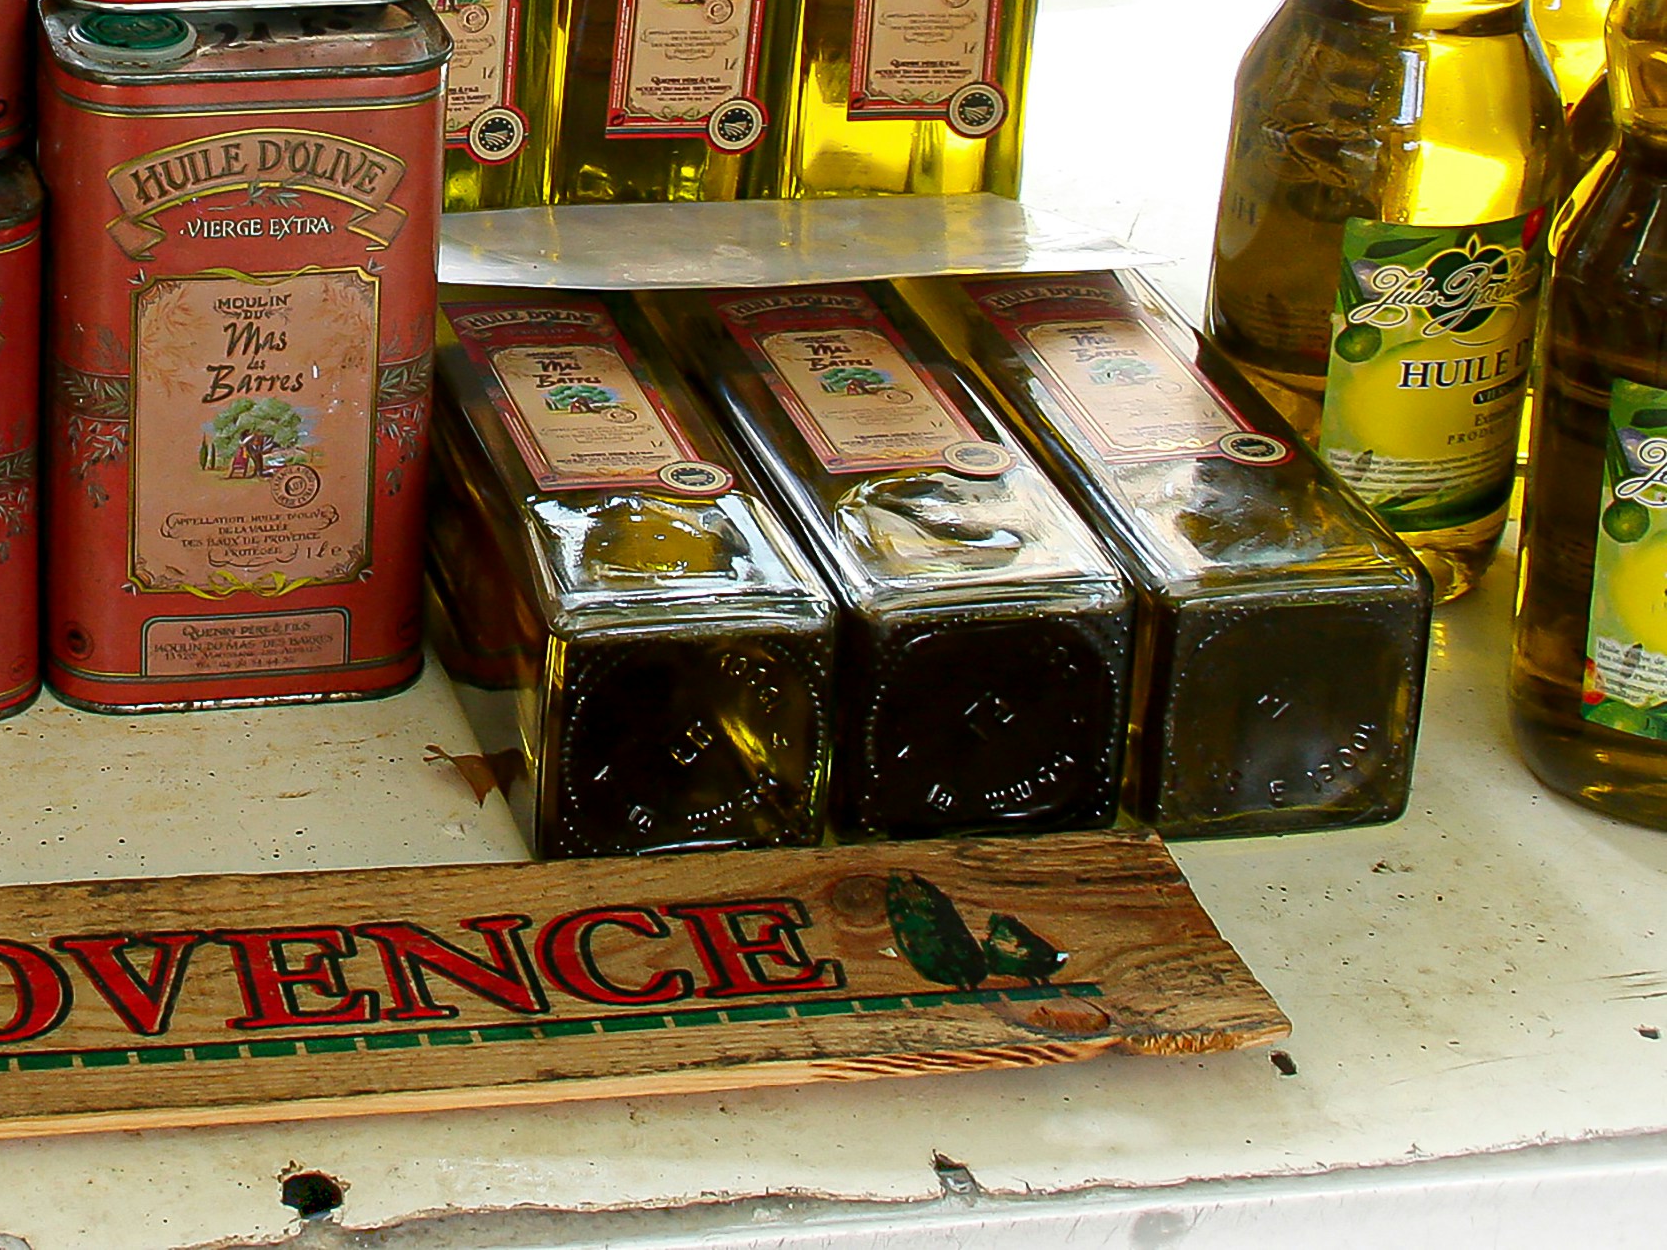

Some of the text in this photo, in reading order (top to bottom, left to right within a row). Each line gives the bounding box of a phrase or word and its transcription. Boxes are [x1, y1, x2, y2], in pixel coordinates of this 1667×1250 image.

[130, 139, 387, 206] HUILE D'OLIVE
[187, 217, 331, 240] VIERGE EXTRA
[215, 293, 292, 309] MOULIN
[243, 309, 263, 320] DU
[222, 321, 287, 357] Mas
[201, 364, 304, 404] Barres
[1397, 348, 1511, 390] HUILE
